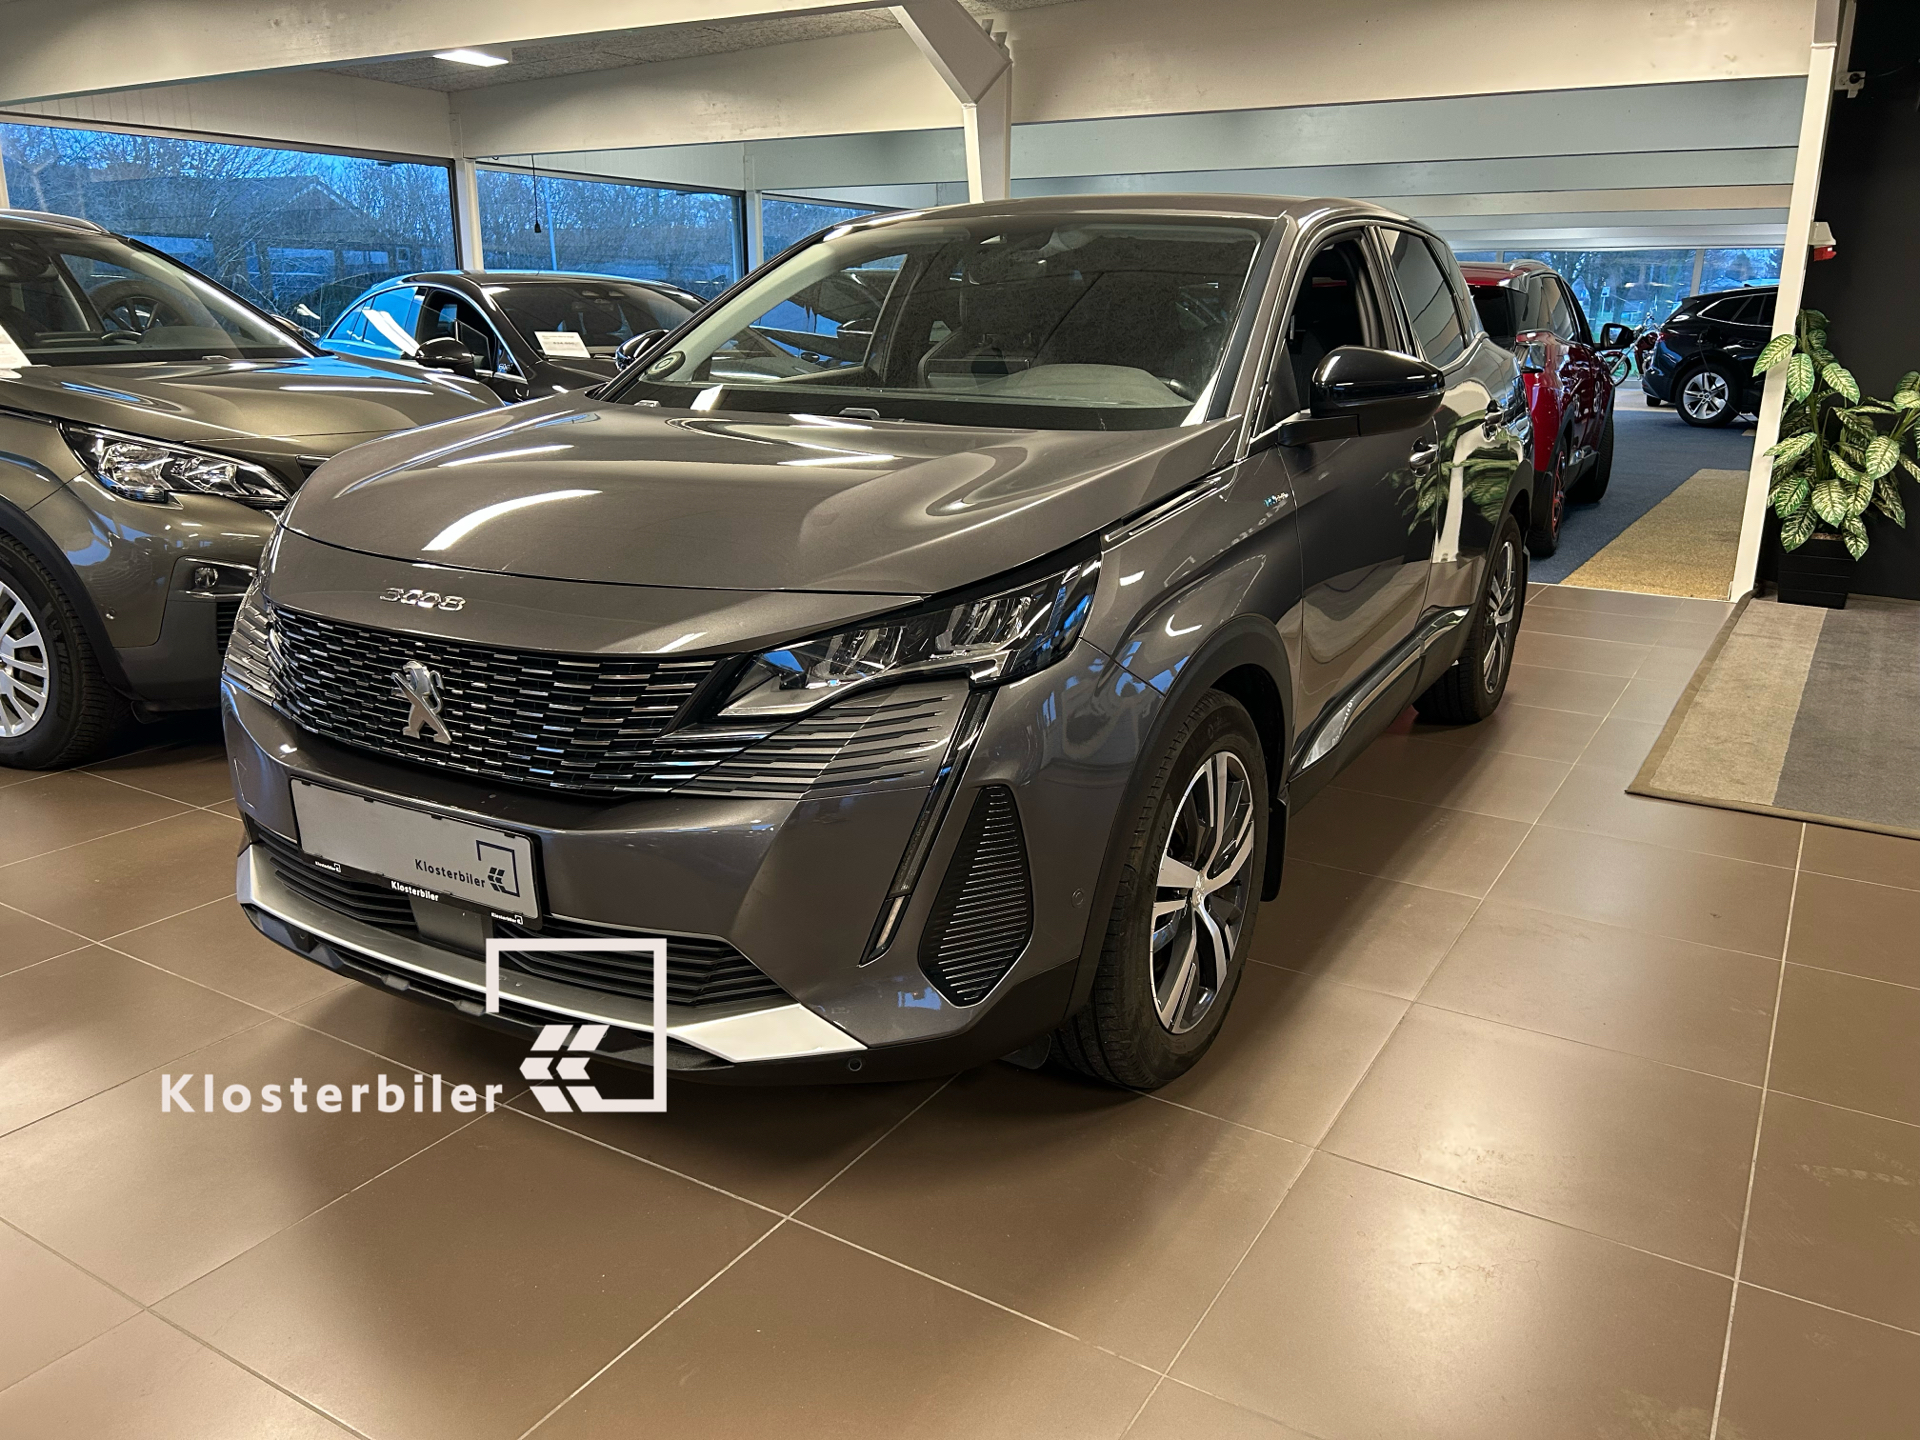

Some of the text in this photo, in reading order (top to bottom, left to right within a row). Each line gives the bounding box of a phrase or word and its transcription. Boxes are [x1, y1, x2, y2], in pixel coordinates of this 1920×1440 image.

[380, 588, 466, 611] 3008
[414, 858, 486, 888] Klosterbiler
[390, 880, 439, 902] Klosterbiler
